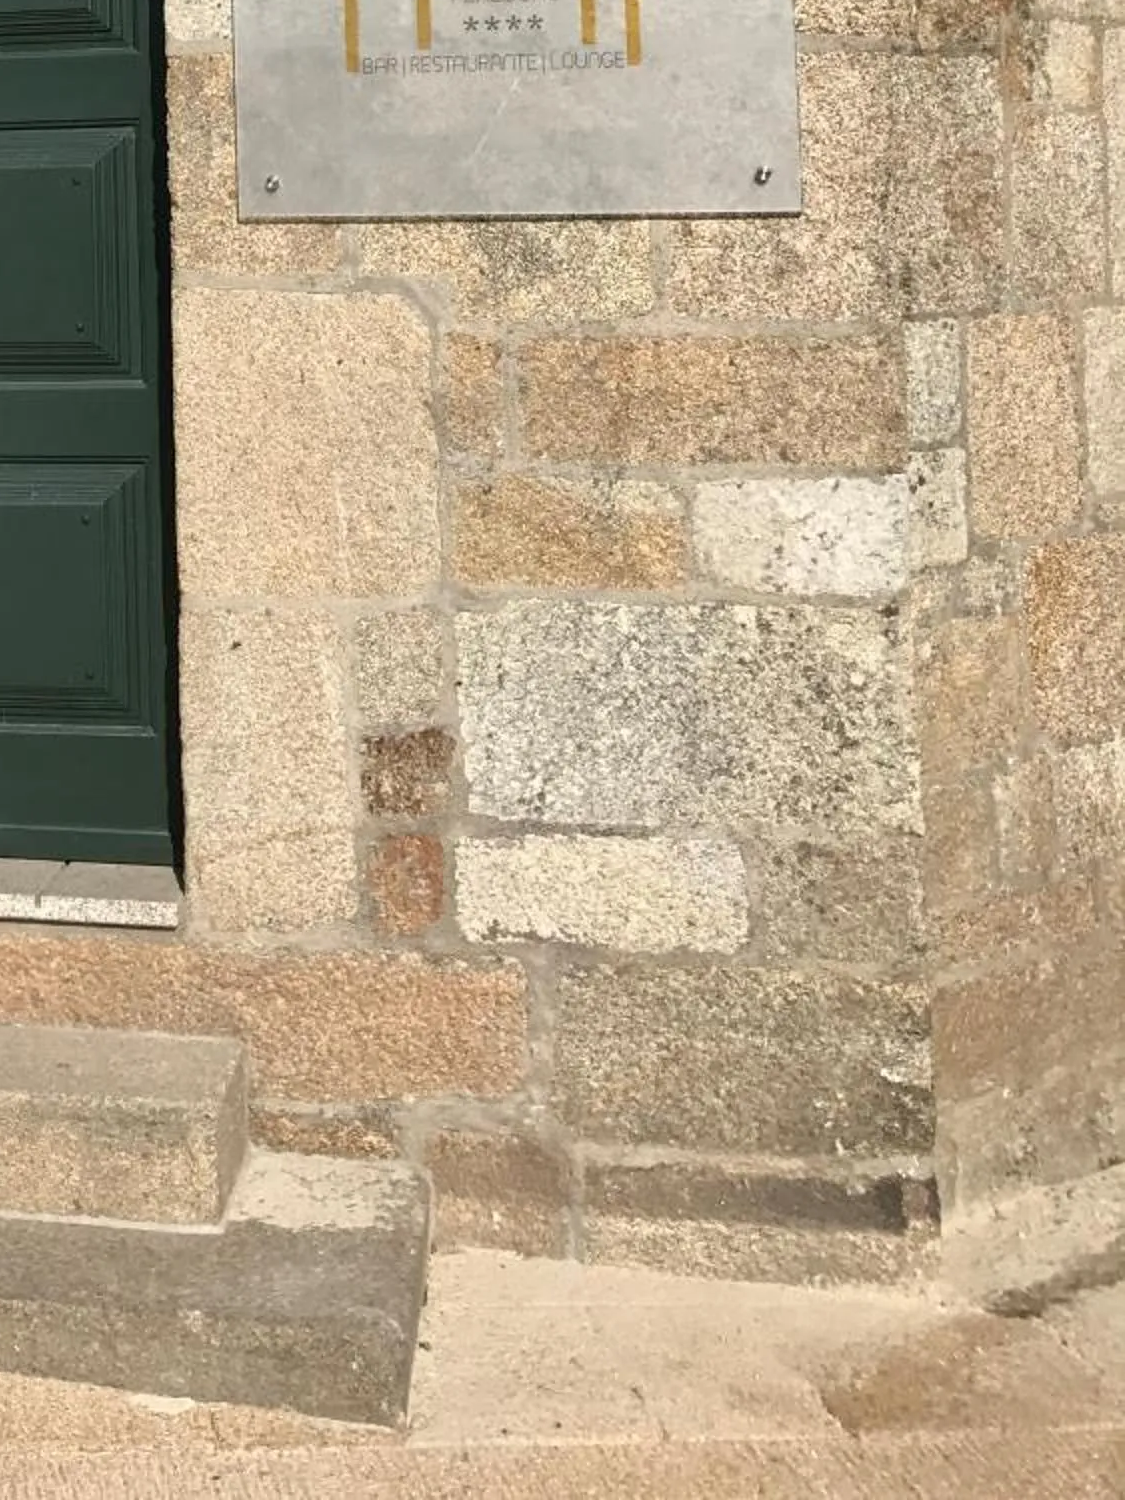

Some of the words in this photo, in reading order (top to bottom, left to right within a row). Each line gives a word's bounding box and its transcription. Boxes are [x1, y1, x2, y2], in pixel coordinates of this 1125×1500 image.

[362, 56, 398, 75] BAR
[410, 52, 538, 74] RESTAURANTE
[549, 51, 625, 71] LOUNGE
